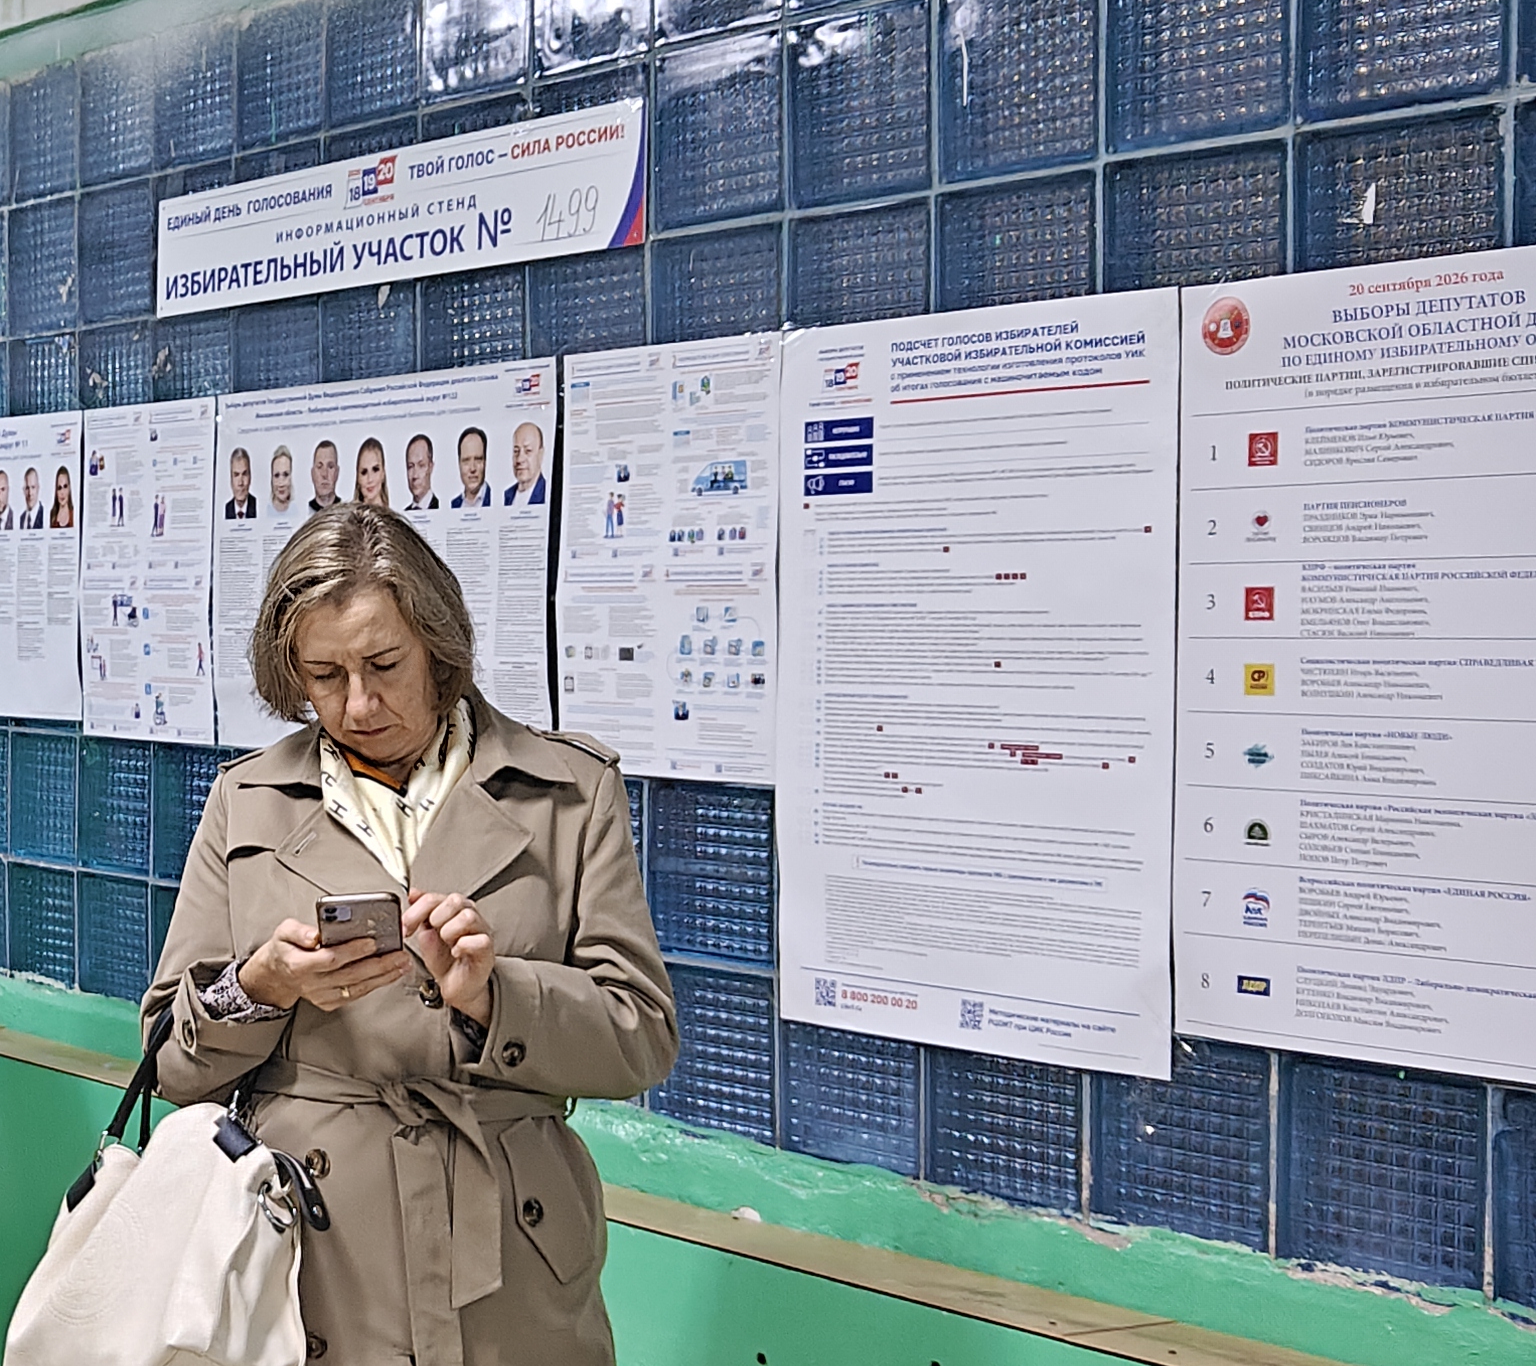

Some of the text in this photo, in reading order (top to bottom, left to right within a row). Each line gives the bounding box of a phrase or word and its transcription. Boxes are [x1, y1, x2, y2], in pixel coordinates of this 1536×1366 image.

[408, 156, 445, 180] ТВОЙ
[448, 148, 495, 173] ГОЛОС
[510, 138, 551, 160] СИЛА
[555, 123, 625, 151] РОССИИ!
[349, 185, 361, 202] 18
[363, 173, 376, 191] 19
[377, 162, 394, 180] 20
[167, 184, 333, 231] ЕДИНЫЙ ДЕНЬ ГОЛОСОВАНИЯ
[275, 194, 478, 243] ИНФОРМАЦИОННЫЙ СТЕНД
[536, 185, 599, 242] 1499
[165, 207, 512, 300] ИЗБИРАТЕЛЬНЫЙ УЧАСТОК №
[1349, 269, 1505, 296] 20 сентября 2026 года
[1332, 290, 1526, 323] ВЫБОРЫ ДЕПУТАТОВ
[891, 320, 1079, 353] ПОДСЧЕТ ГОЛОСОВ ИЗБИРАТЕЛЕЙ
[1283, 322, 1403, 350] МОСКОВСКОЙ
[1408, 311, 1521, 338] ОБЛАСТНОЙ
[891, 330, 1146, 367] УЧАСТКОВОЙ ИЗБИРАТЕЛЬНОЙ КОМИССИЕЙ
[1065, 352, 1122, 366] протоколов
[1124, 348, 1146, 359] УИК
[1281, 355, 1302, 368] ПО
[1305, 348, 1375, 367] ЕДИНОМУ
[1380, 335, 1521, 359] ИЗБИРАТЕЛЬНОМУ
[1225, 374, 1312, 391] ПОЛИТИЧЕСКИЕ
[1315, 370, 1365, 385] ПАРТИИ,
[1367, 357, 1509, 379] ЗАРЕГИСТРИРОВАВШИЕ
[1495, 410, 1535, 422] ПАРТИЯ
[1210, 445, 1217, 461] 1
[1207, 519, 1217, 536] 2
[1206, 594, 1216, 610] 3
[1205, 668, 1216, 685] 4
[1204, 742, 1215, 759] 5
[1204, 817, 1215, 833] 6
[1201, 891, 1212, 907] 7
[1201, 973, 1210, 989] 8
[850, 990, 868, 1003] 800
[870, 993, 889, 1006] 200
[891, 996, 903, 1008] 00
[905, 999, 918, 1010] 20
